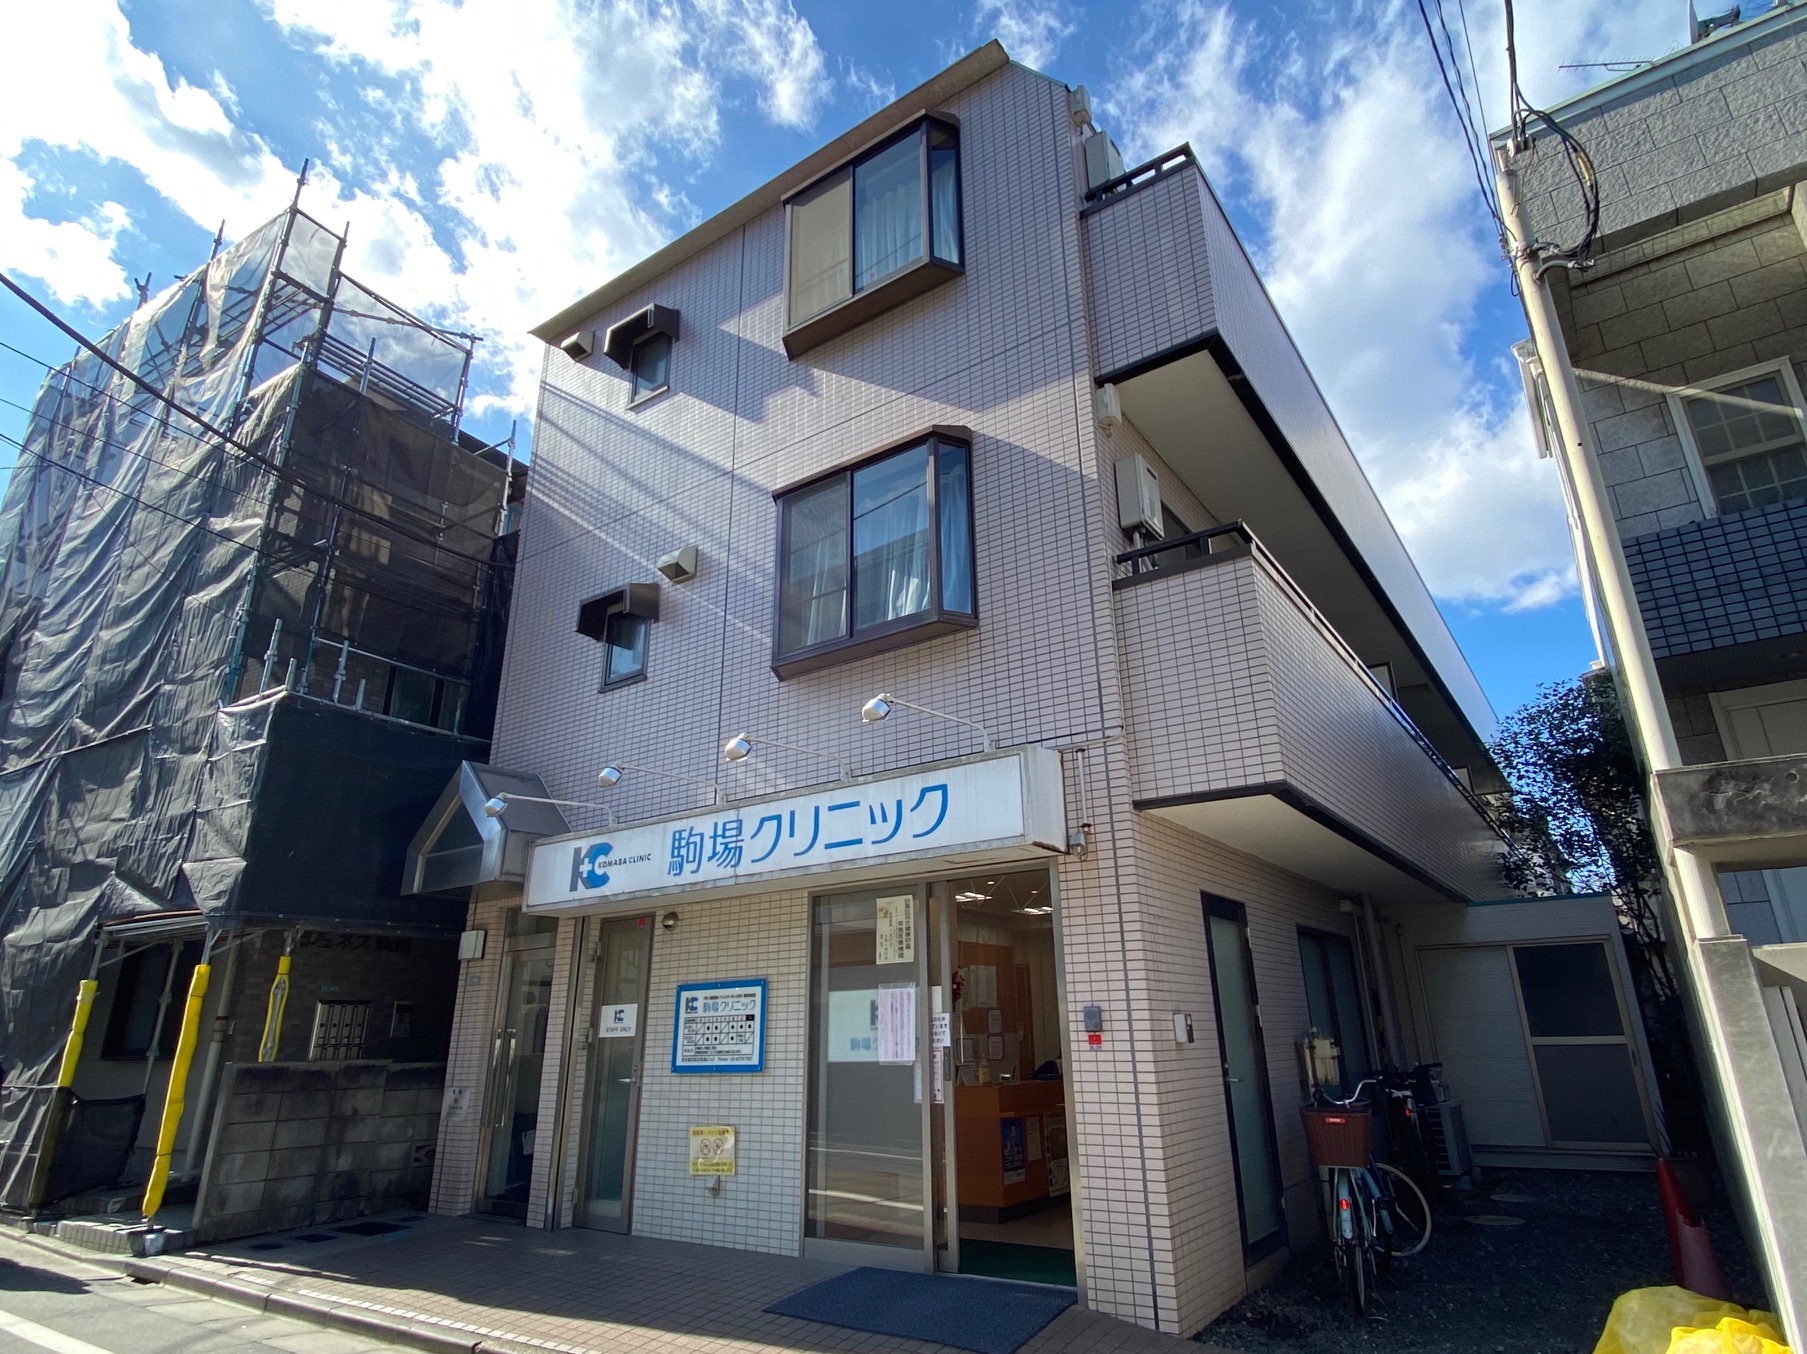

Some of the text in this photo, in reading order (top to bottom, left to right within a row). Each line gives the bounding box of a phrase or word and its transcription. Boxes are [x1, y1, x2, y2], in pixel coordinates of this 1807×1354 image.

[667, 783, 948, 877] 駒場クリニック
[597, 853, 652, 869] KOMABA CLINIC
